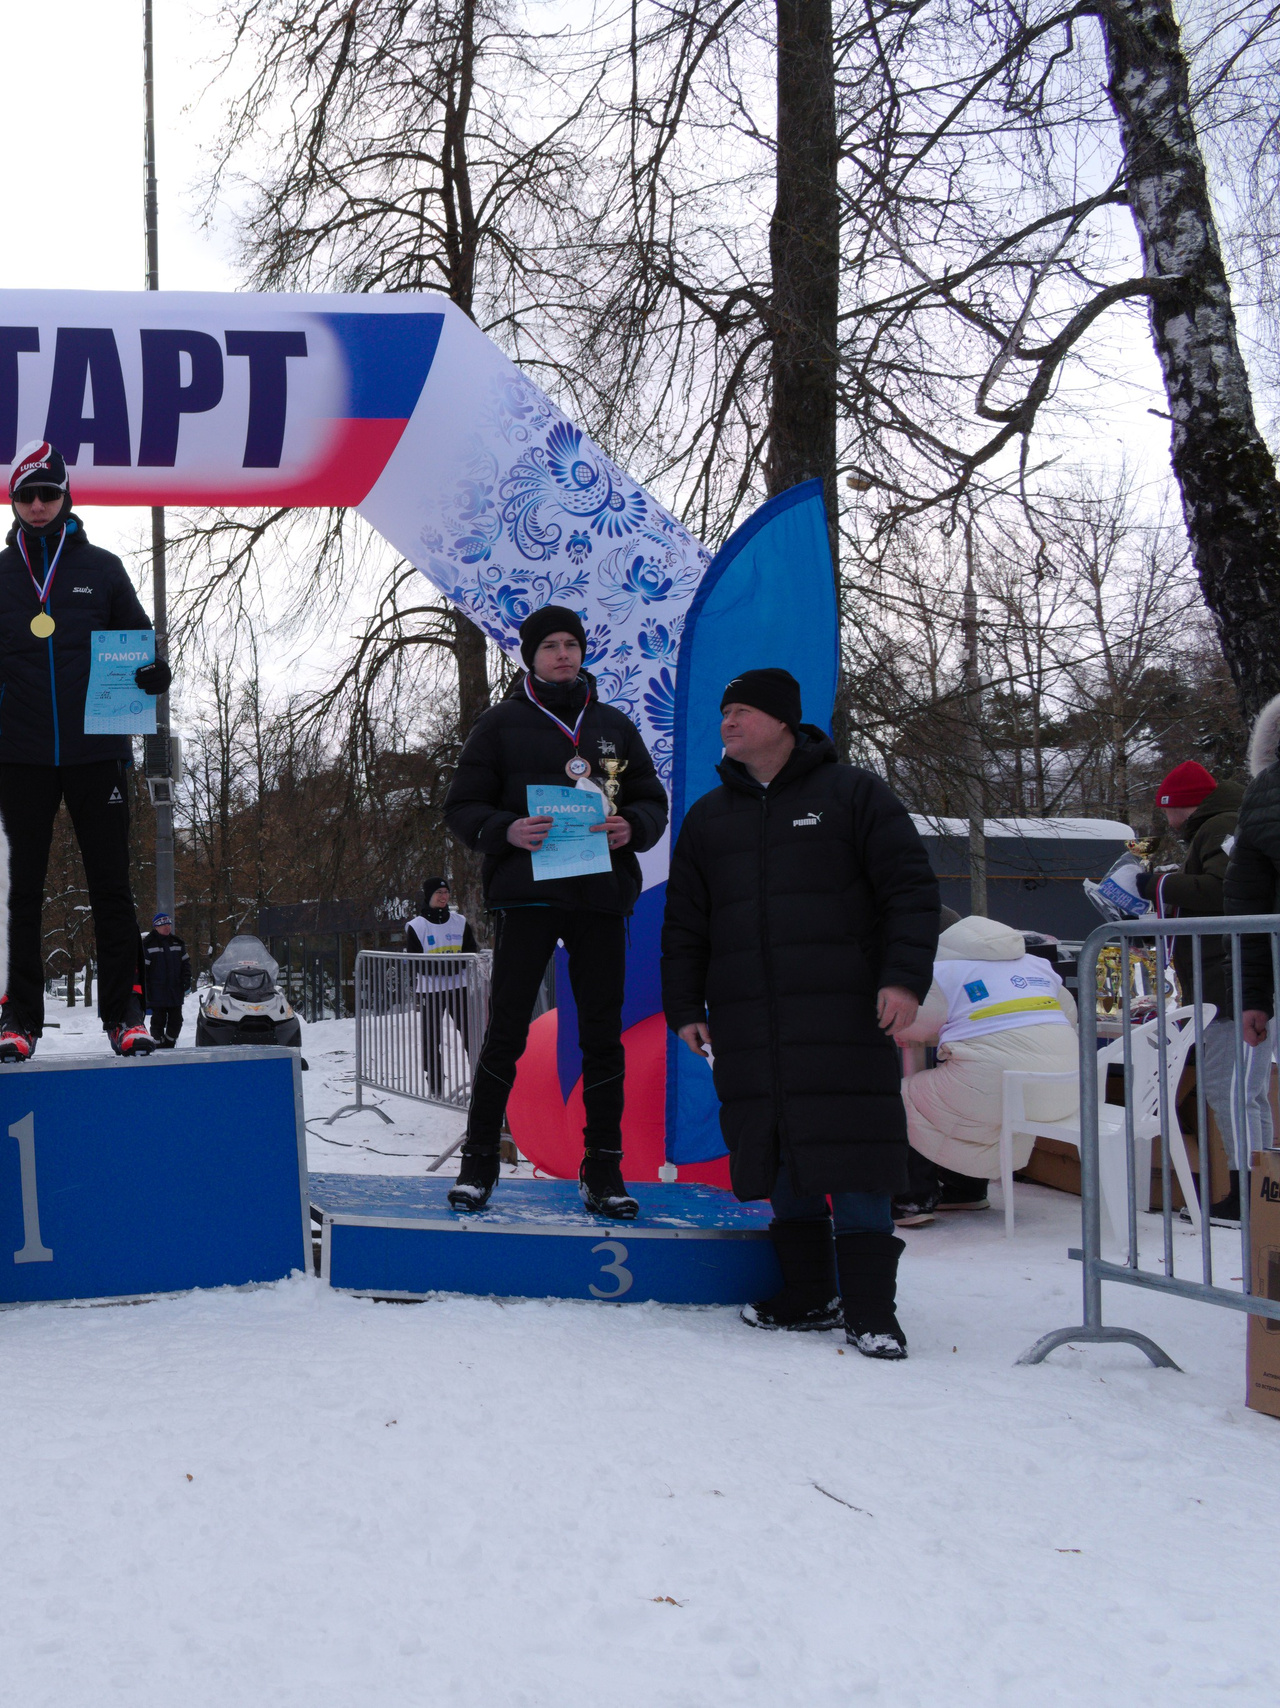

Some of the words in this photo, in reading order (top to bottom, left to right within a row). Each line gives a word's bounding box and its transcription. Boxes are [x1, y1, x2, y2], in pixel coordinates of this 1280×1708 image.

[20, 461, 49, 472] LUKOIL
[98, 652, 149, 662] ГРАМОТА
[536, 804, 596, 815] ГРАМОТА
[793, 818, 817, 827] PUMA
[8, 1110, 53, 1264] 1
[588, 1240, 634, 1298] 3
